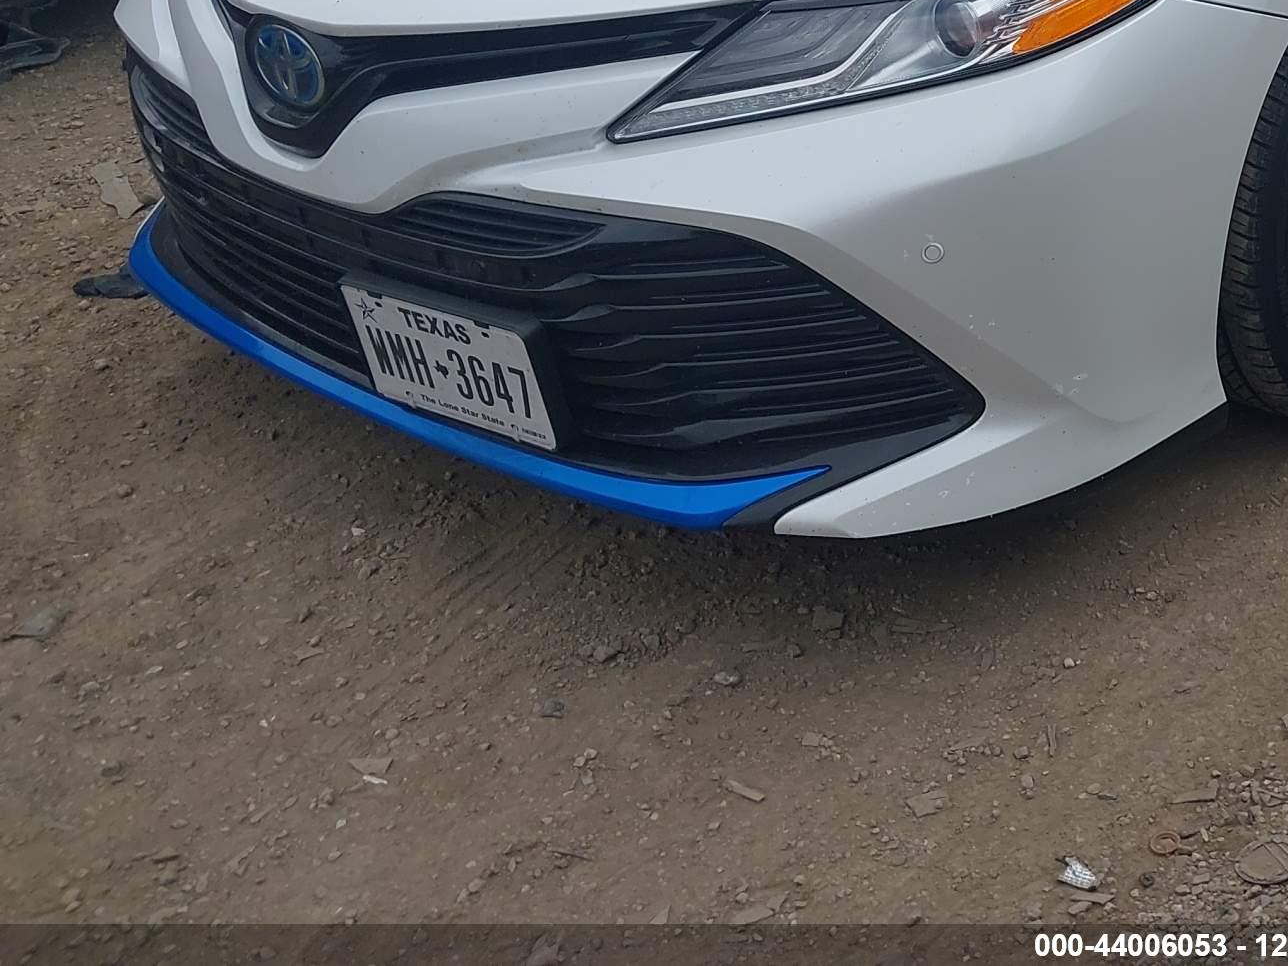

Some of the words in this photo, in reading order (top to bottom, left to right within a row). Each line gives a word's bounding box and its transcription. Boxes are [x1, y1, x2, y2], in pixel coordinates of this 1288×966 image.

[397, 306, 472, 346] TEXAS
[420, 393, 437, 404] The
[437, 399, 459, 412] Lone
[460, 406, 479, 419] Star
[481, 413, 505, 427] State
